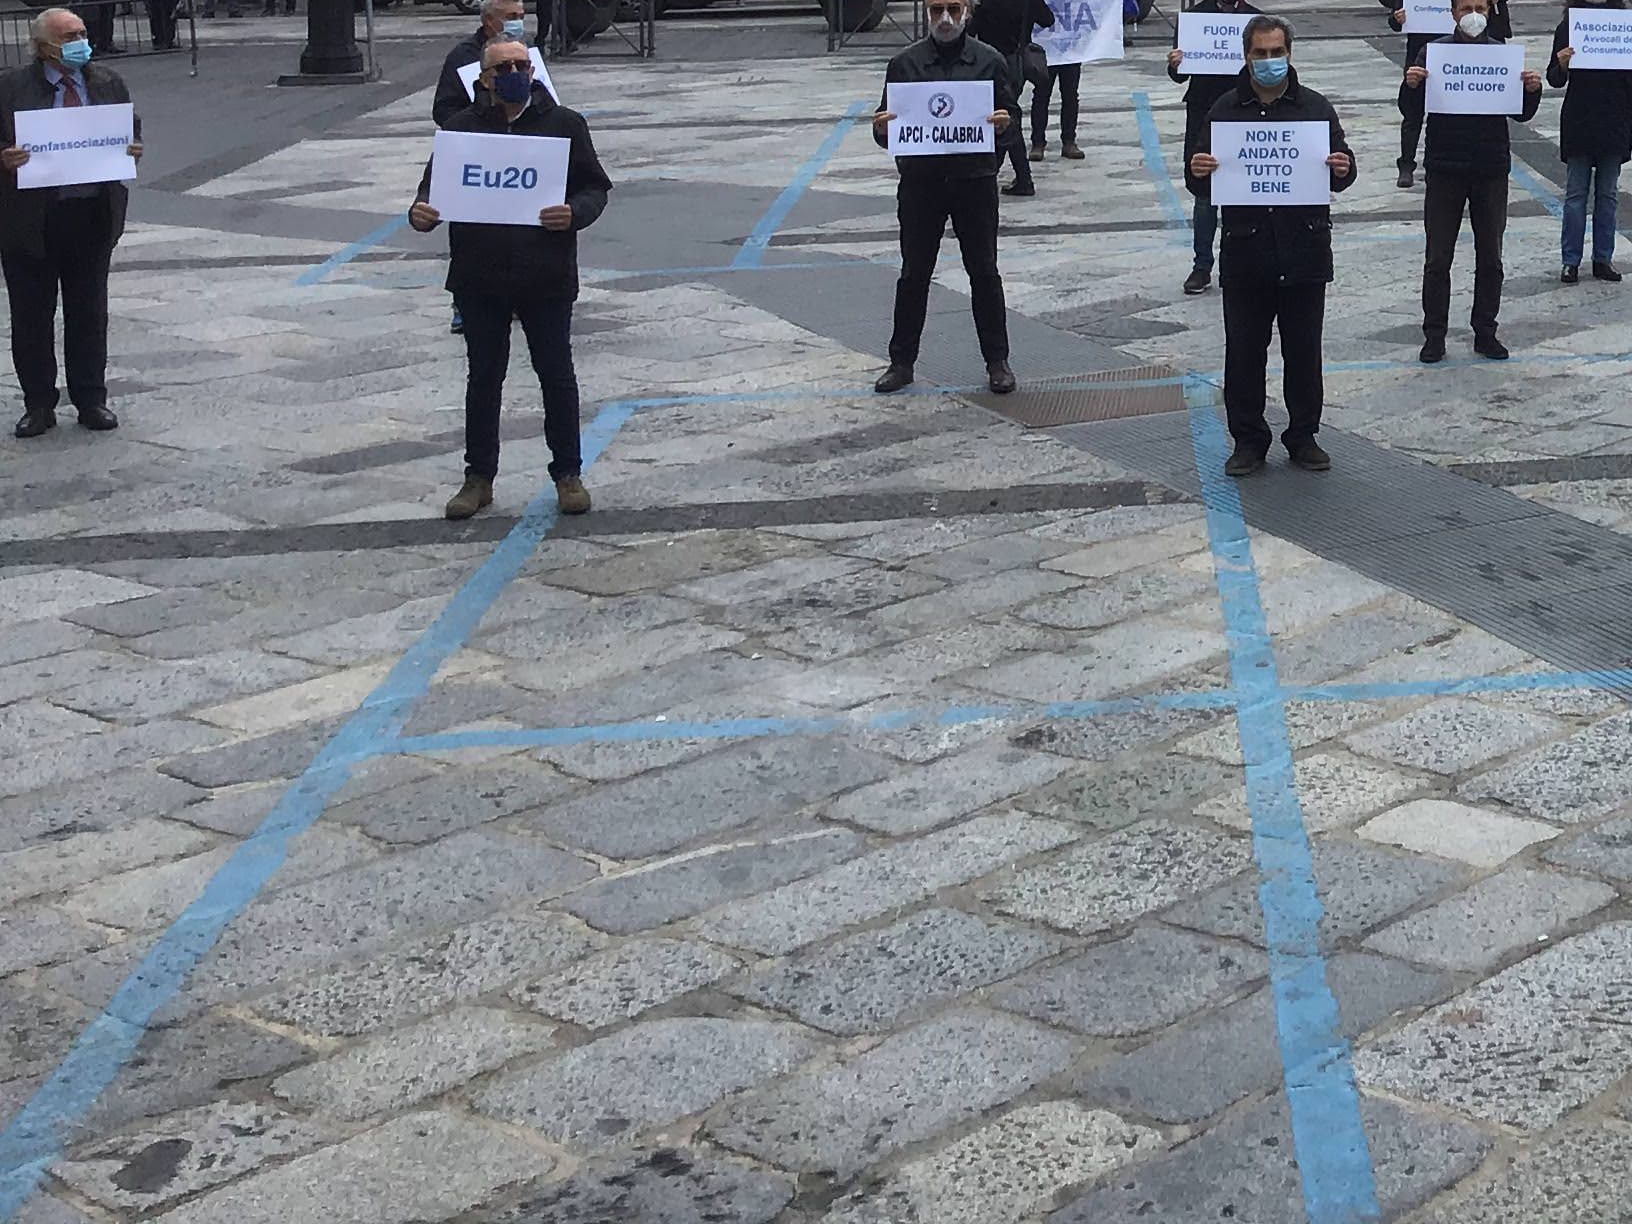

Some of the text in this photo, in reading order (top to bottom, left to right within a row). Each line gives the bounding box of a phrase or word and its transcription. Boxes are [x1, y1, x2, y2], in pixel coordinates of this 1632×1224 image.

[1203, 26, 1240, 35] FUORI
[1214, 40, 1229, 49] LE
[1442, 63, 1509, 76] Catanzaro
[1444, 81, 1506, 92] nel cuore
[899, 126, 923, 143] APCI
[932, 126, 984, 143] CALABRIA
[1246, 130, 1278, 142] NON
[22, 136, 130, 154] Confassociazioni
[1238, 147, 1299, 159] ANDATO
[462, 164, 538, 189] Eu20
[1245, 165, 1292, 176] TUTTO
[1251, 181, 1290, 193] BENE
